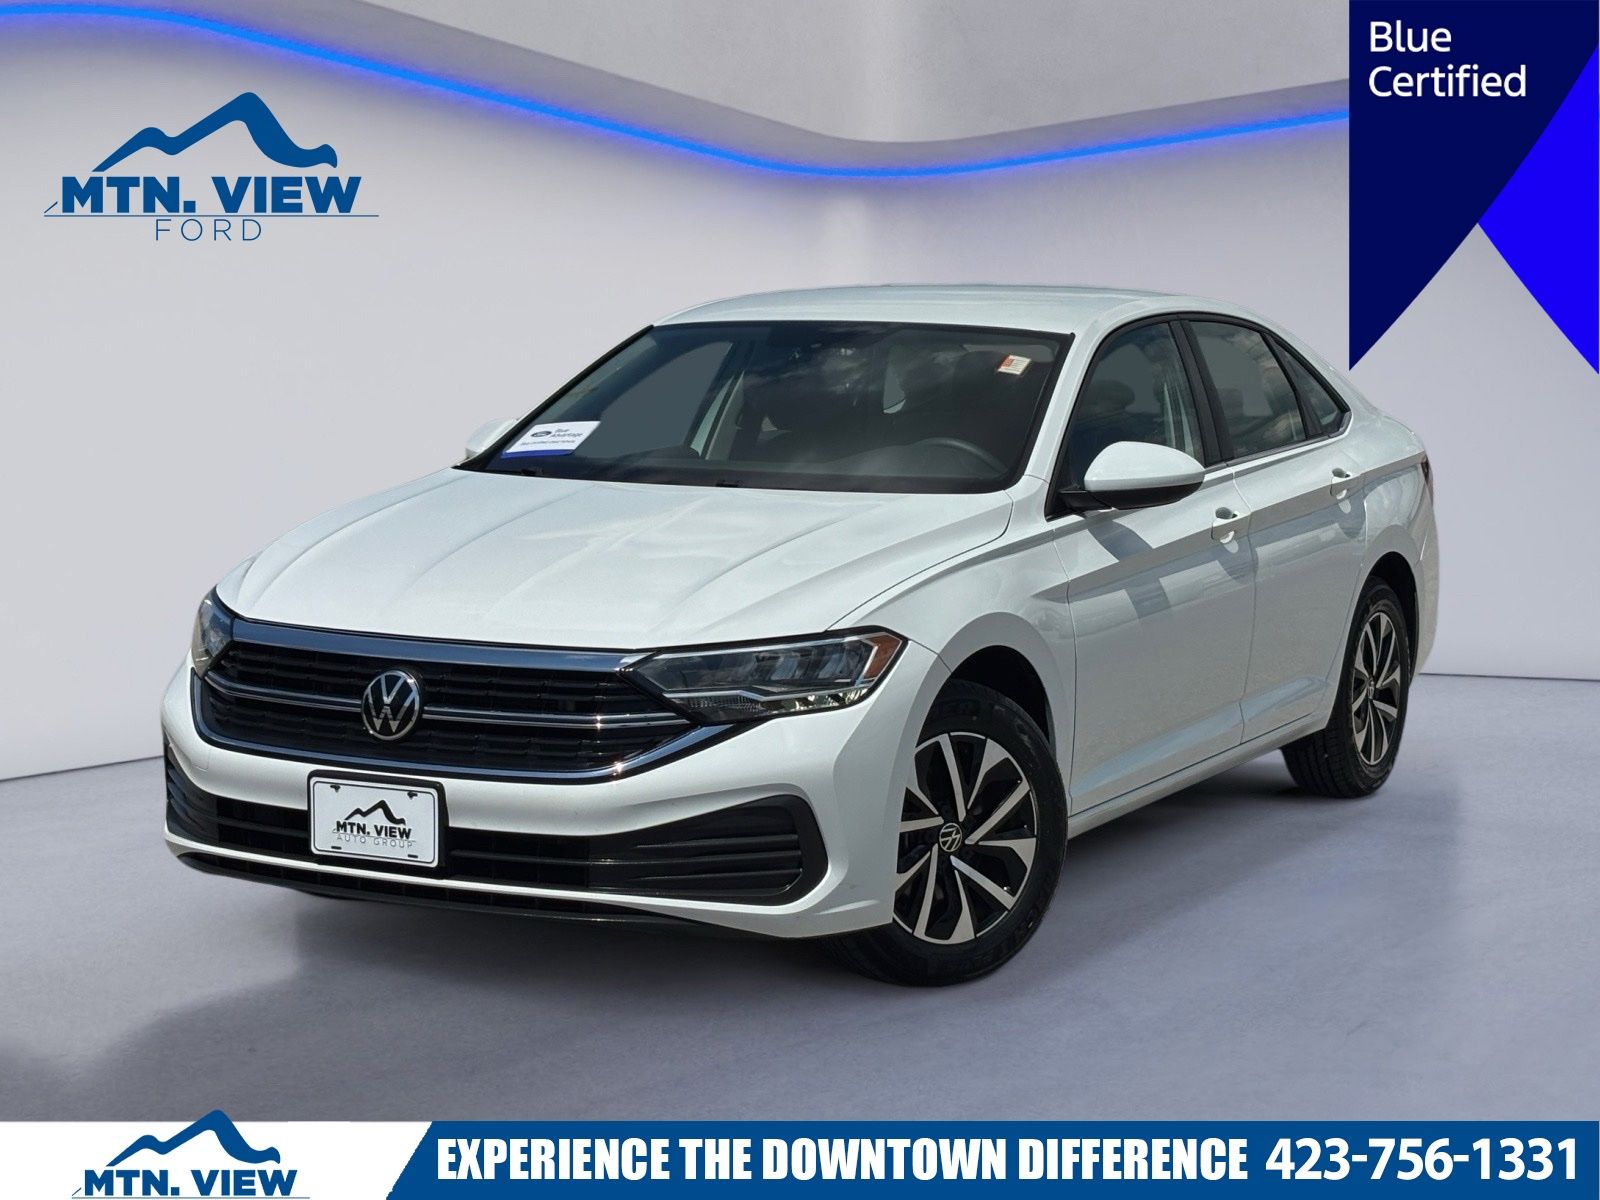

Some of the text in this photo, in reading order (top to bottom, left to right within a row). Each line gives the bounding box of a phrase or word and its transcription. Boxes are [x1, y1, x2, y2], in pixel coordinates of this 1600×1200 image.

[336, 820, 412, 840] MTN. VIEW
[337, 834, 413, 848] AUTO GROUP
